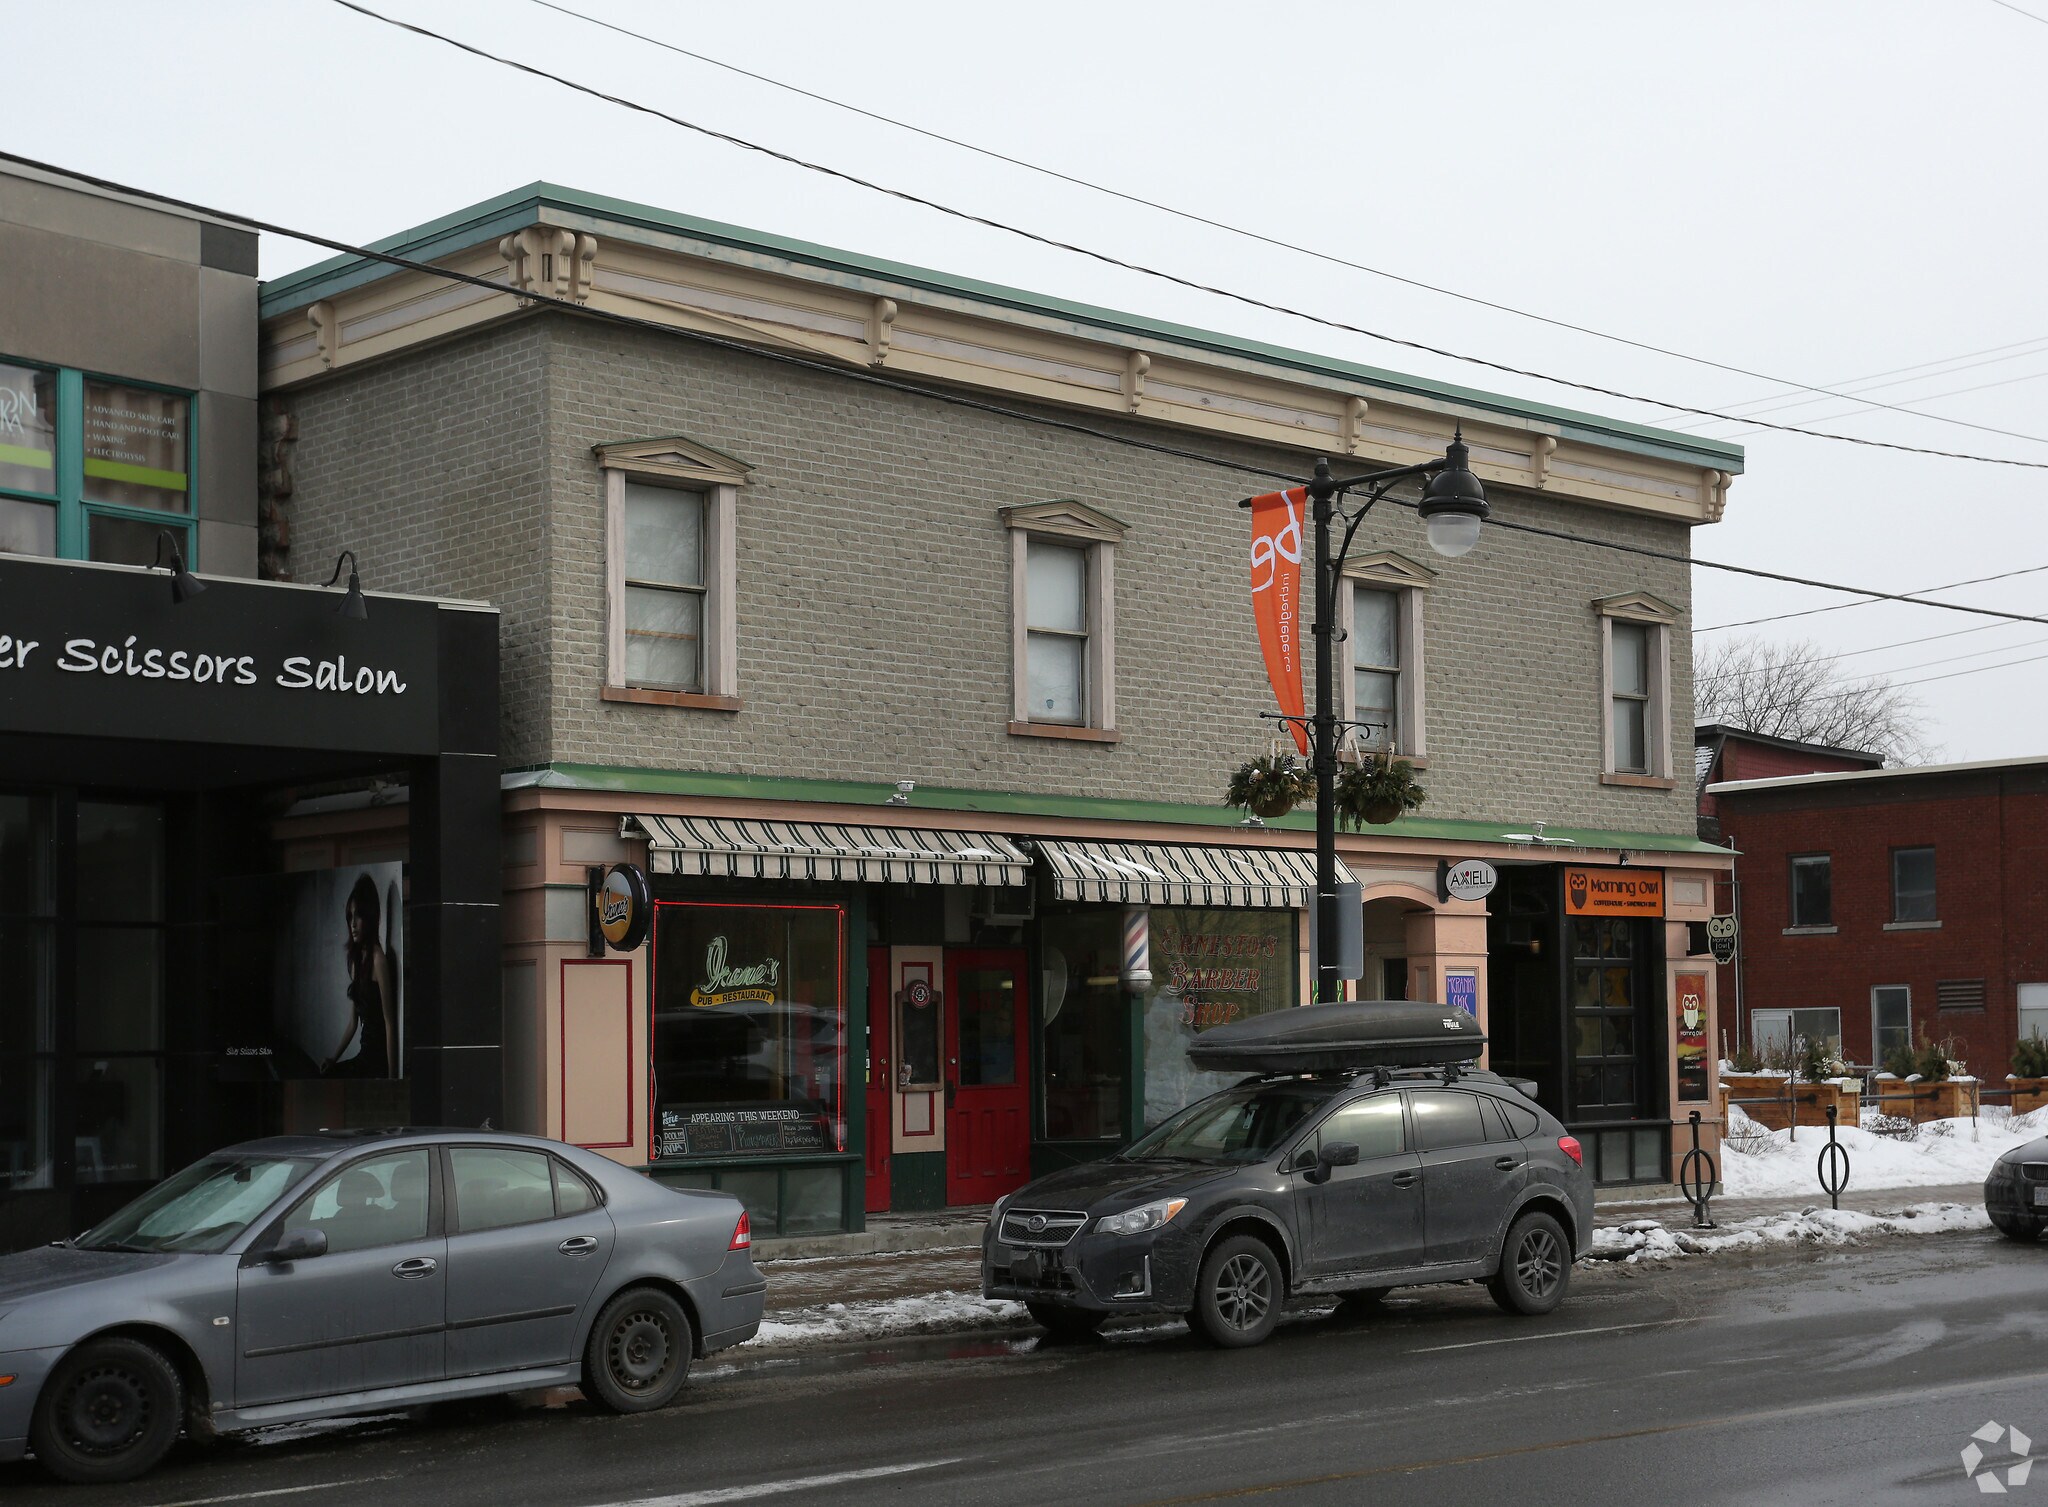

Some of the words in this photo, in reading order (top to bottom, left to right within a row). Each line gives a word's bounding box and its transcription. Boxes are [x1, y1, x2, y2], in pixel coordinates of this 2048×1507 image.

[92, 405, 136, 419] ADVANCED
[137, 412, 157, 423] SKIN
[92, 420, 118, 431] HAND
[119, 423, 137, 433] AND
[138, 426, 161, 437] FOOT
[161, 430, 181, 440] CARE
[92, 434, 127, 446] WAXING
[92, 447, 146, 463] ELECTROLYSIS
[56, 635, 258, 686] Scissors
[276, 655, 407, 695] Salon
[1450, 869, 1493, 887] AXIELL
[1591, 879, 1637, 897] Morning
[1638, 880, 1659, 895] Owl
[699, 935, 780, 994] Irene's
[1165, 958, 1261, 996] BARBER
[697, 996, 713, 1006] PUB
[722, 990, 772, 1003] RESTAURANT
[1179, 994, 1240, 1027] SHOP
[690, 1111, 736, 1124] APPEARING
[737, 1111, 757, 1121] THIS
[758, 1109, 800, 1121] WEEKEND
